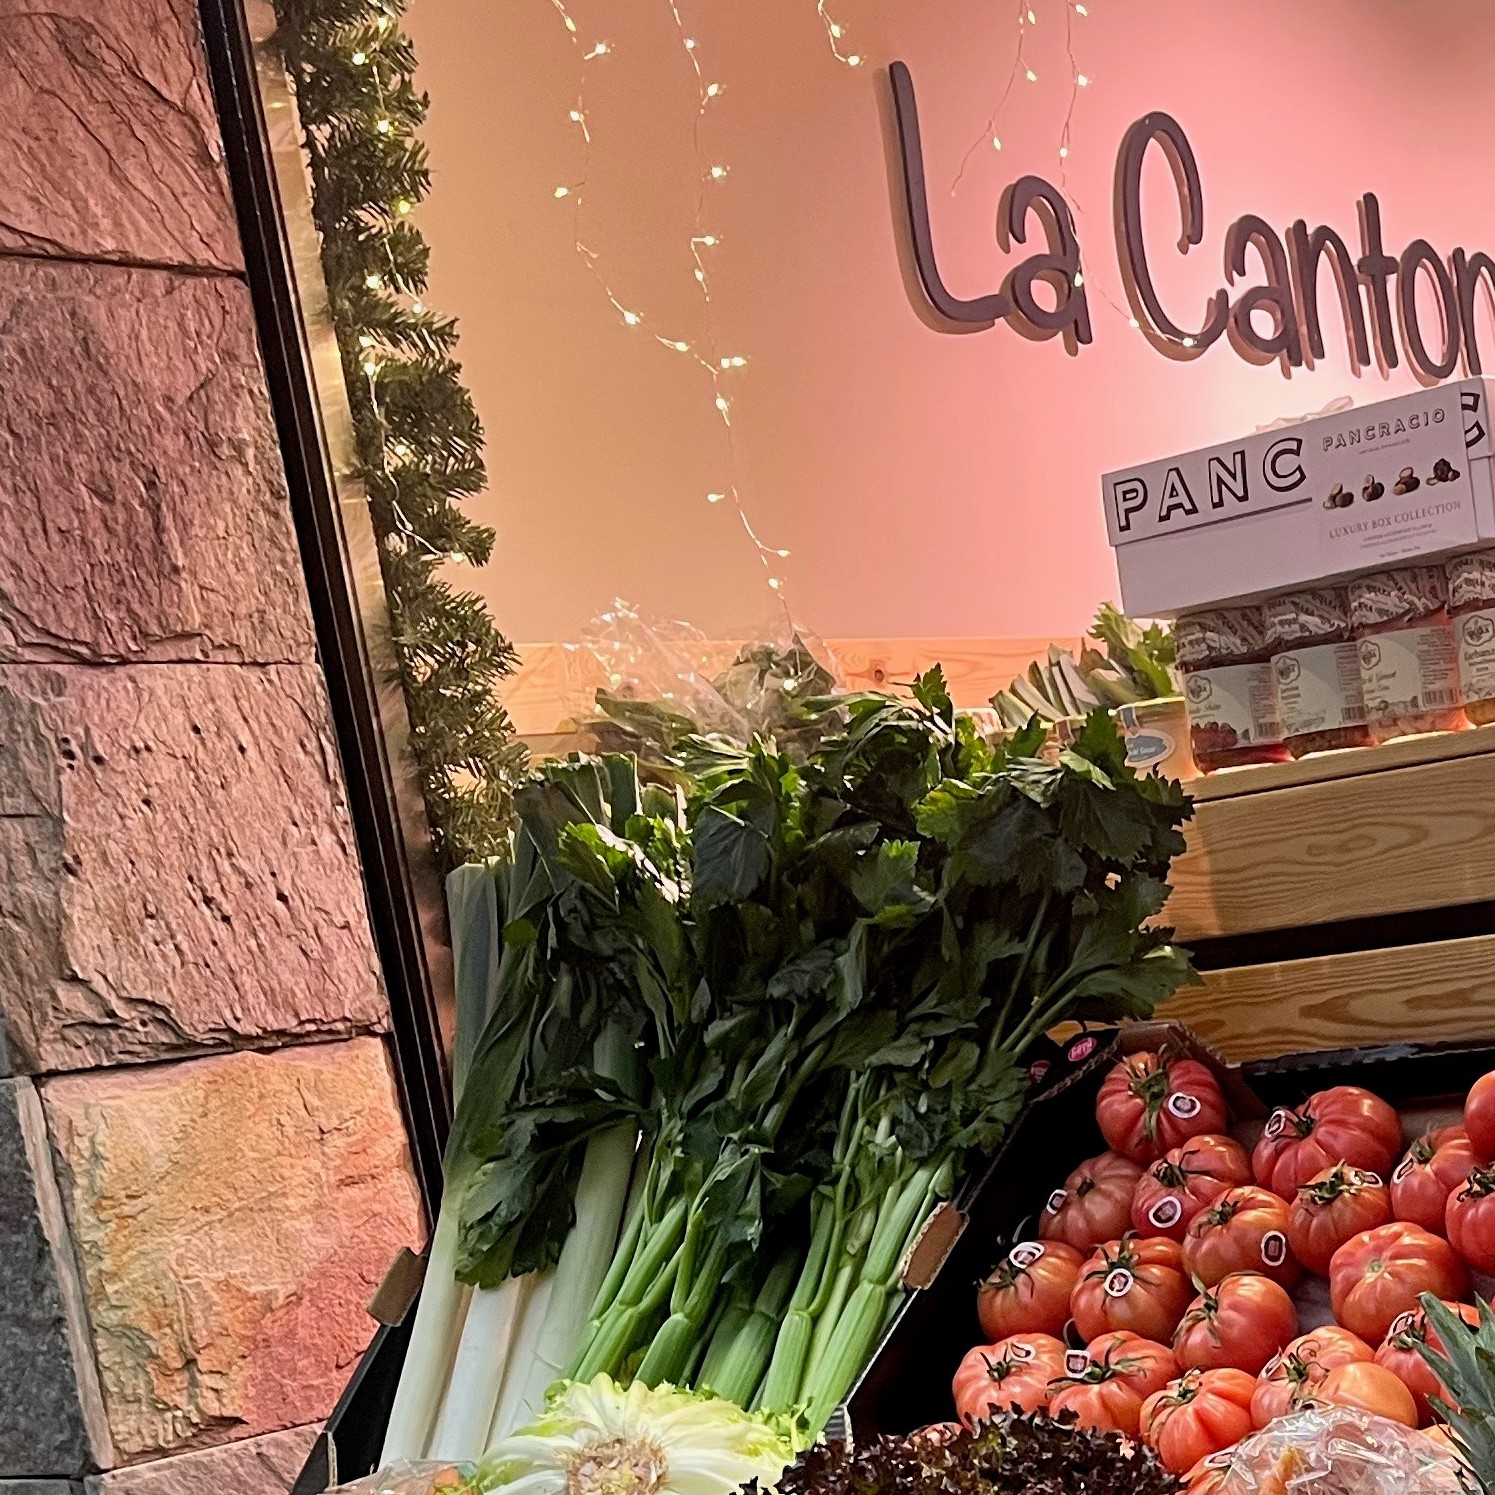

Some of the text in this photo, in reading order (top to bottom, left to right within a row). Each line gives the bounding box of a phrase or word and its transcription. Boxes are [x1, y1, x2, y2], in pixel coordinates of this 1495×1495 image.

[884, 58, 1093, 350] La
[1322, 408, 1446, 452] PANCRACIO
[1328, 521, 1369, 540] LUXURY
[1371, 515, 1392, 531] BOX
[1394, 500, 1462, 525] COLLECTION
